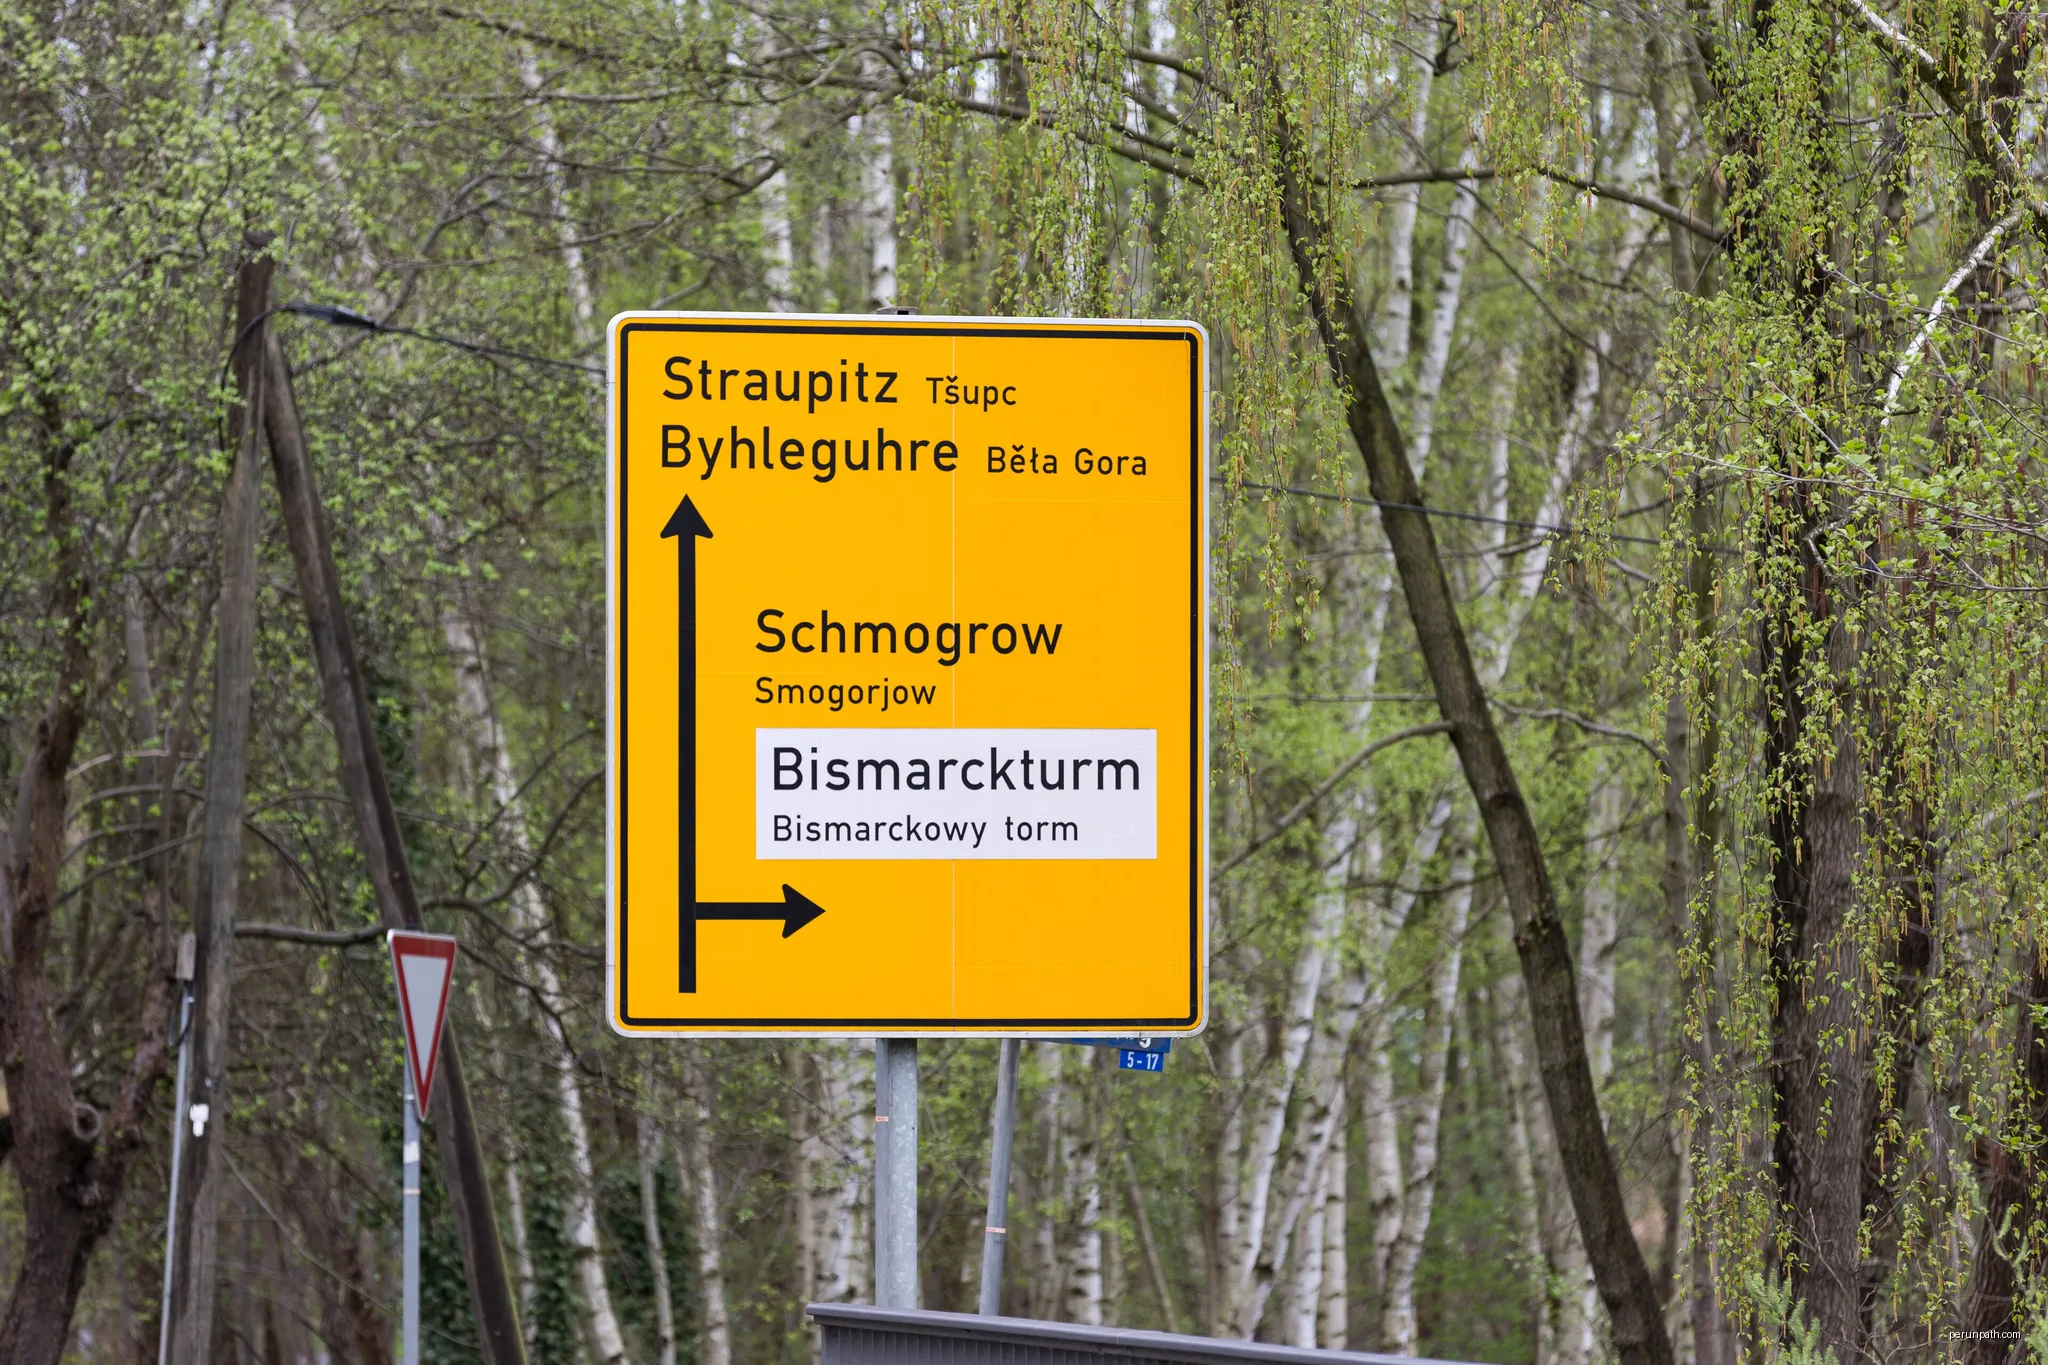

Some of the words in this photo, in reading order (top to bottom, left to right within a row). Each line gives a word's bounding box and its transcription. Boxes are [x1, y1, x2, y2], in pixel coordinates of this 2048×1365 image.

[663, 356, 898, 413] Straupitz
[926, 376, 1017, 412] Tšupc
[661, 425, 959, 483] Byhleguhre
[987, 445, 1058, 474] Běła
[1074, 448, 1147, 476] Gora
[755, 608, 1063, 667] Schmogrow
[755, 677, 937, 712] Smogorjow
[773, 747, 1140, 791] Bismarckturm
[774, 814, 987, 848] Bismarckowy
[1005, 817, 1078, 841] torm
